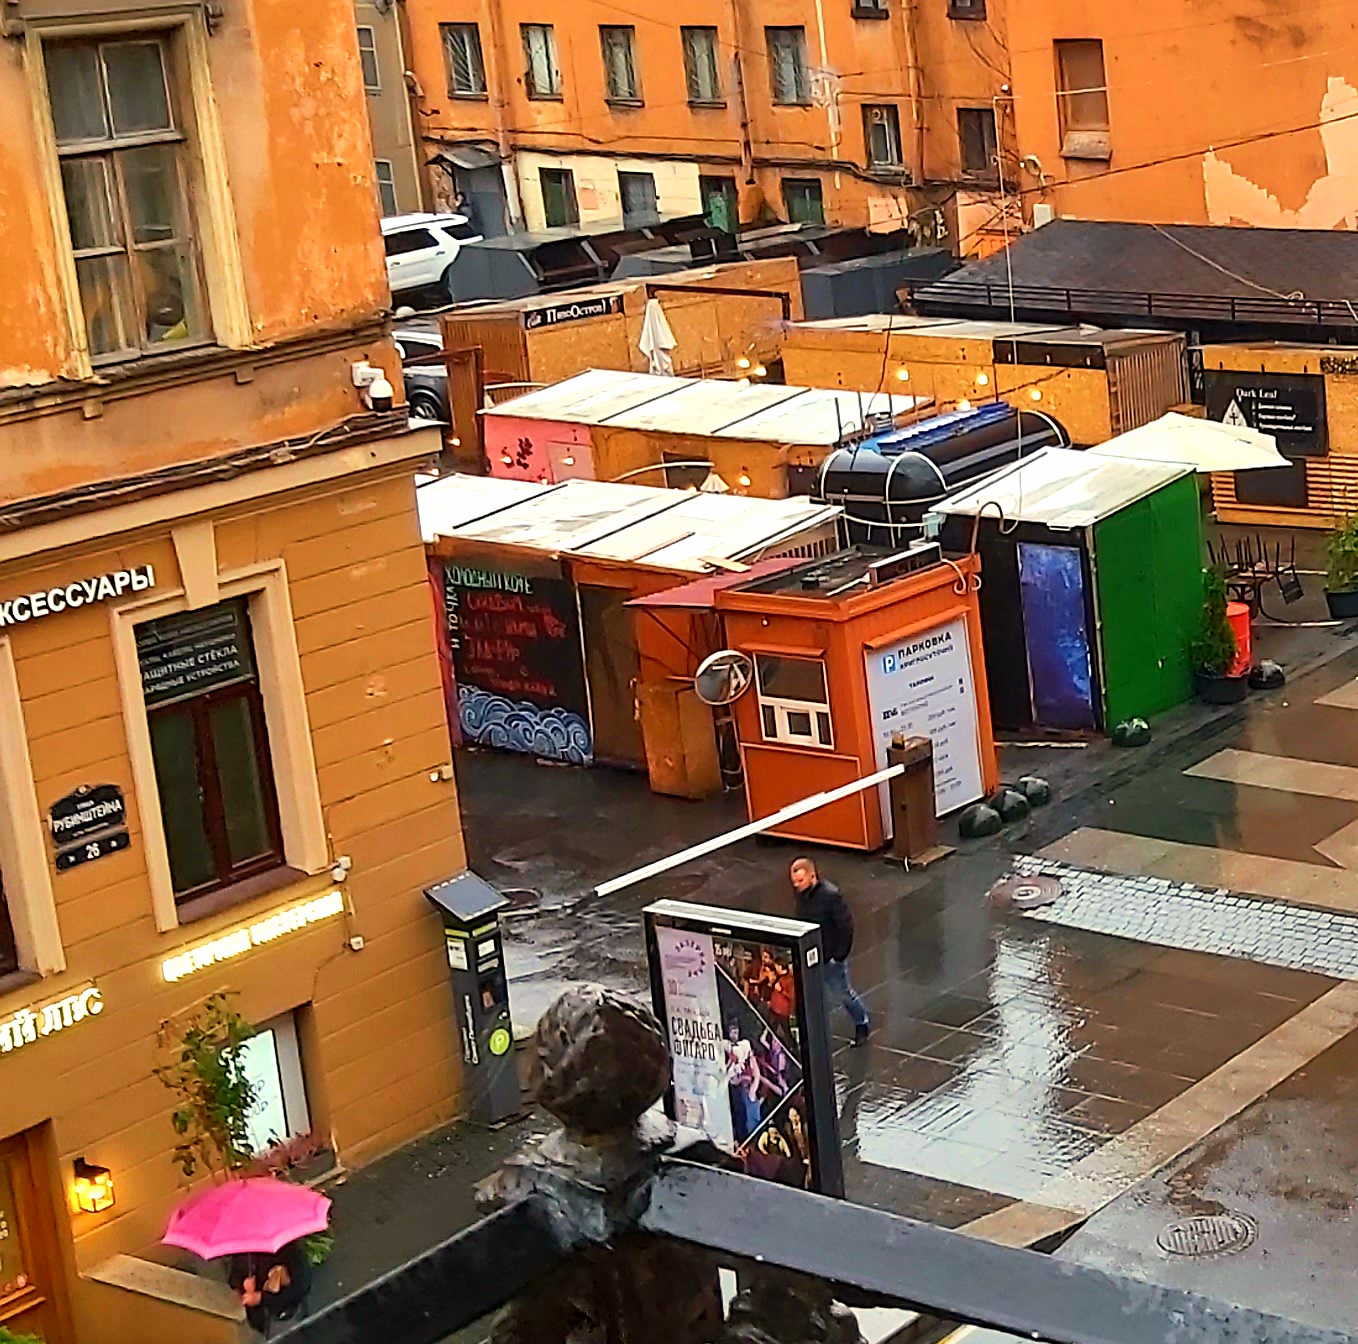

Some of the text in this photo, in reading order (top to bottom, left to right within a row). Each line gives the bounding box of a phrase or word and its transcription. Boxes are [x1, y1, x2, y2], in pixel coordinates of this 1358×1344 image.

[898, 631, 952, 659] ПАРКОВКА
[85, 842, 100, 859] 26
[671, 1016, 722, 1042] СВАДЬБА
[674, 1038, 716, 1061] ФИГАРО
